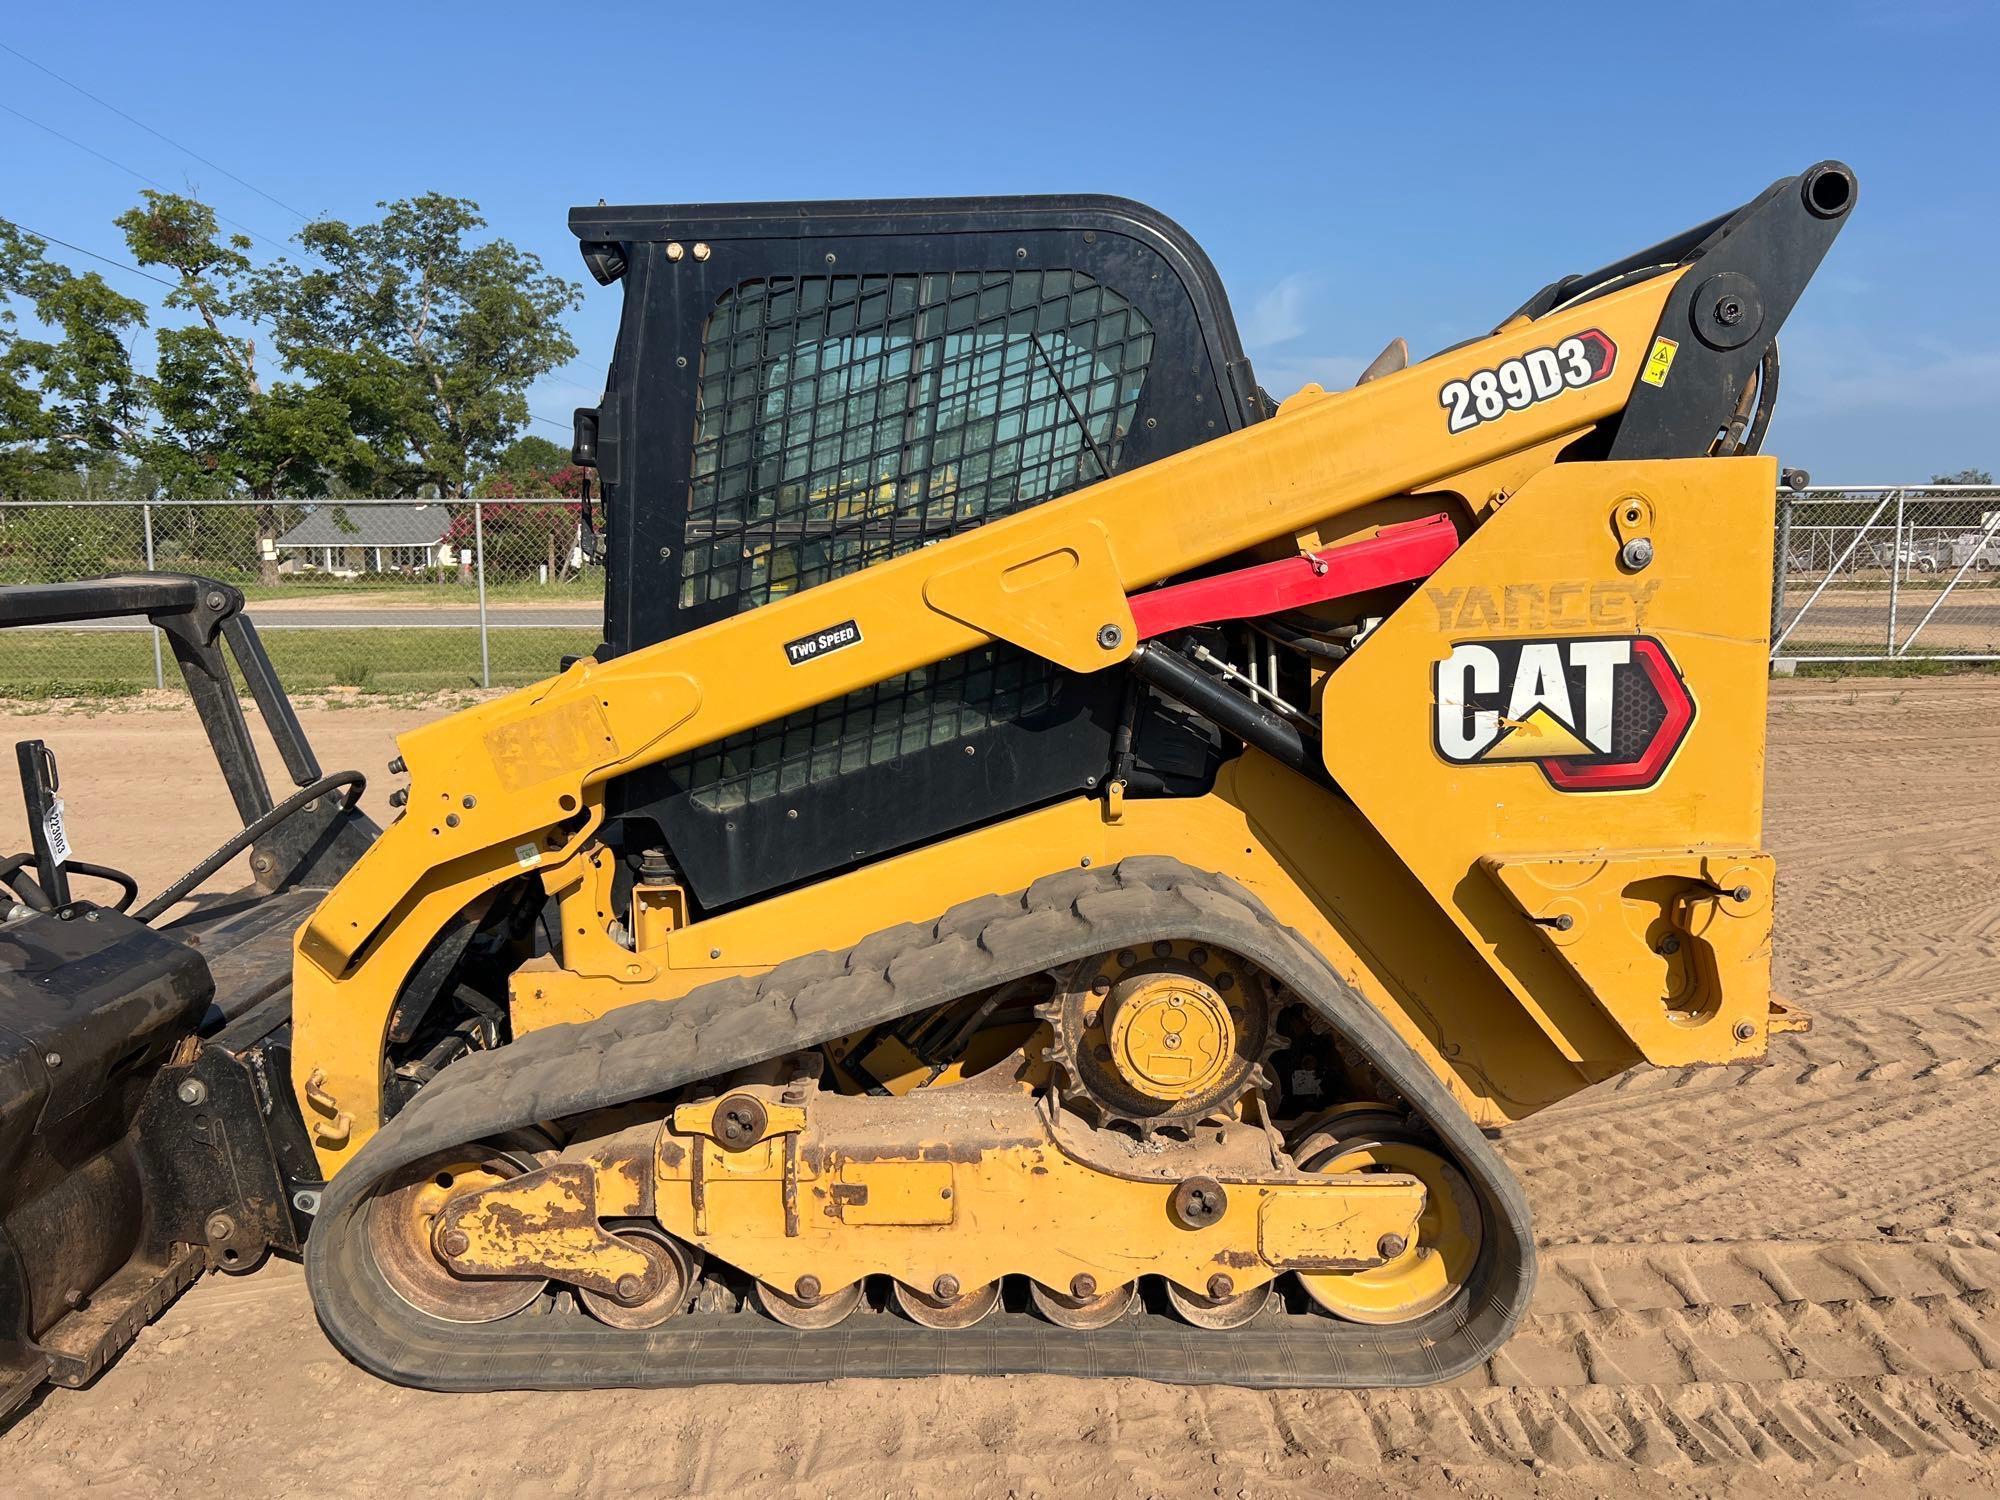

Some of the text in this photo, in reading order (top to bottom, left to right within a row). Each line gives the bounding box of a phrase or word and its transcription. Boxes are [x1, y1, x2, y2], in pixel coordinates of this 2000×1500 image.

[1441, 338, 1593, 431] 289D3
[1427, 580, 1660, 631] YANCEY
[818, 627, 854, 649] SPEED
[1438, 642, 1631, 759] CAT
[50, 813, 66, 854] 223003
